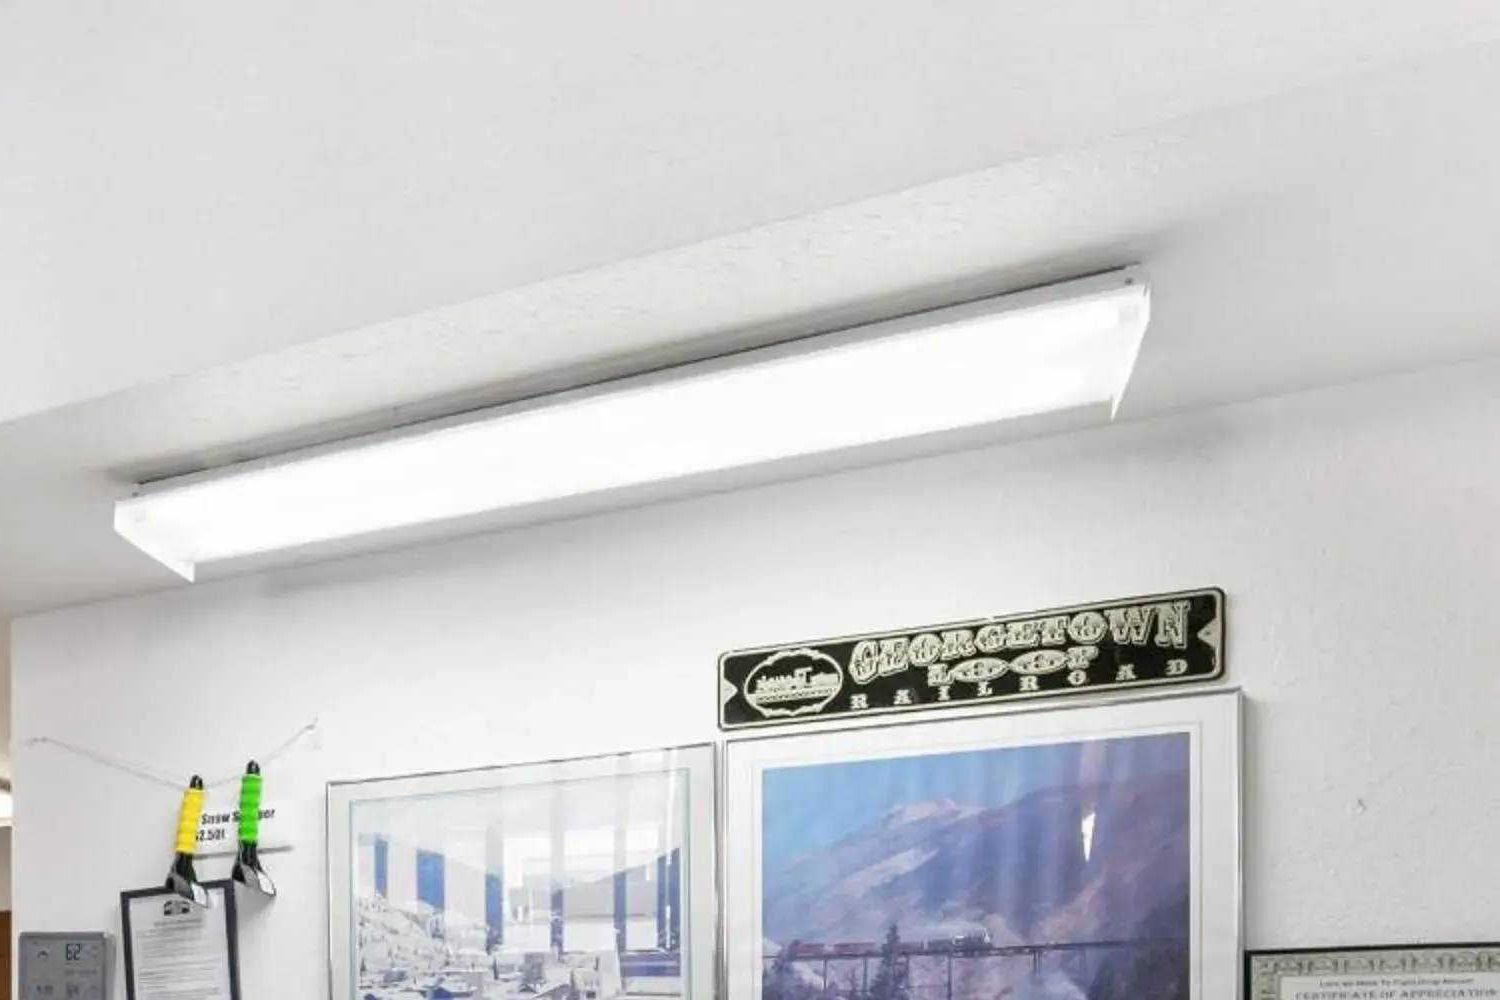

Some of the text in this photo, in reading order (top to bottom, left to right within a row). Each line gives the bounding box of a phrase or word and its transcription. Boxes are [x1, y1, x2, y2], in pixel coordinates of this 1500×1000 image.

[849, 600, 1192, 686] GEORGETOWN
[927, 645, 1099, 687] LOOP
[850, 658, 1188, 710] RAILROAD
[1294, 990, 1374, 1000] CERTIFICATE
[1401, 987, 1498, 999] APPRECIATION
